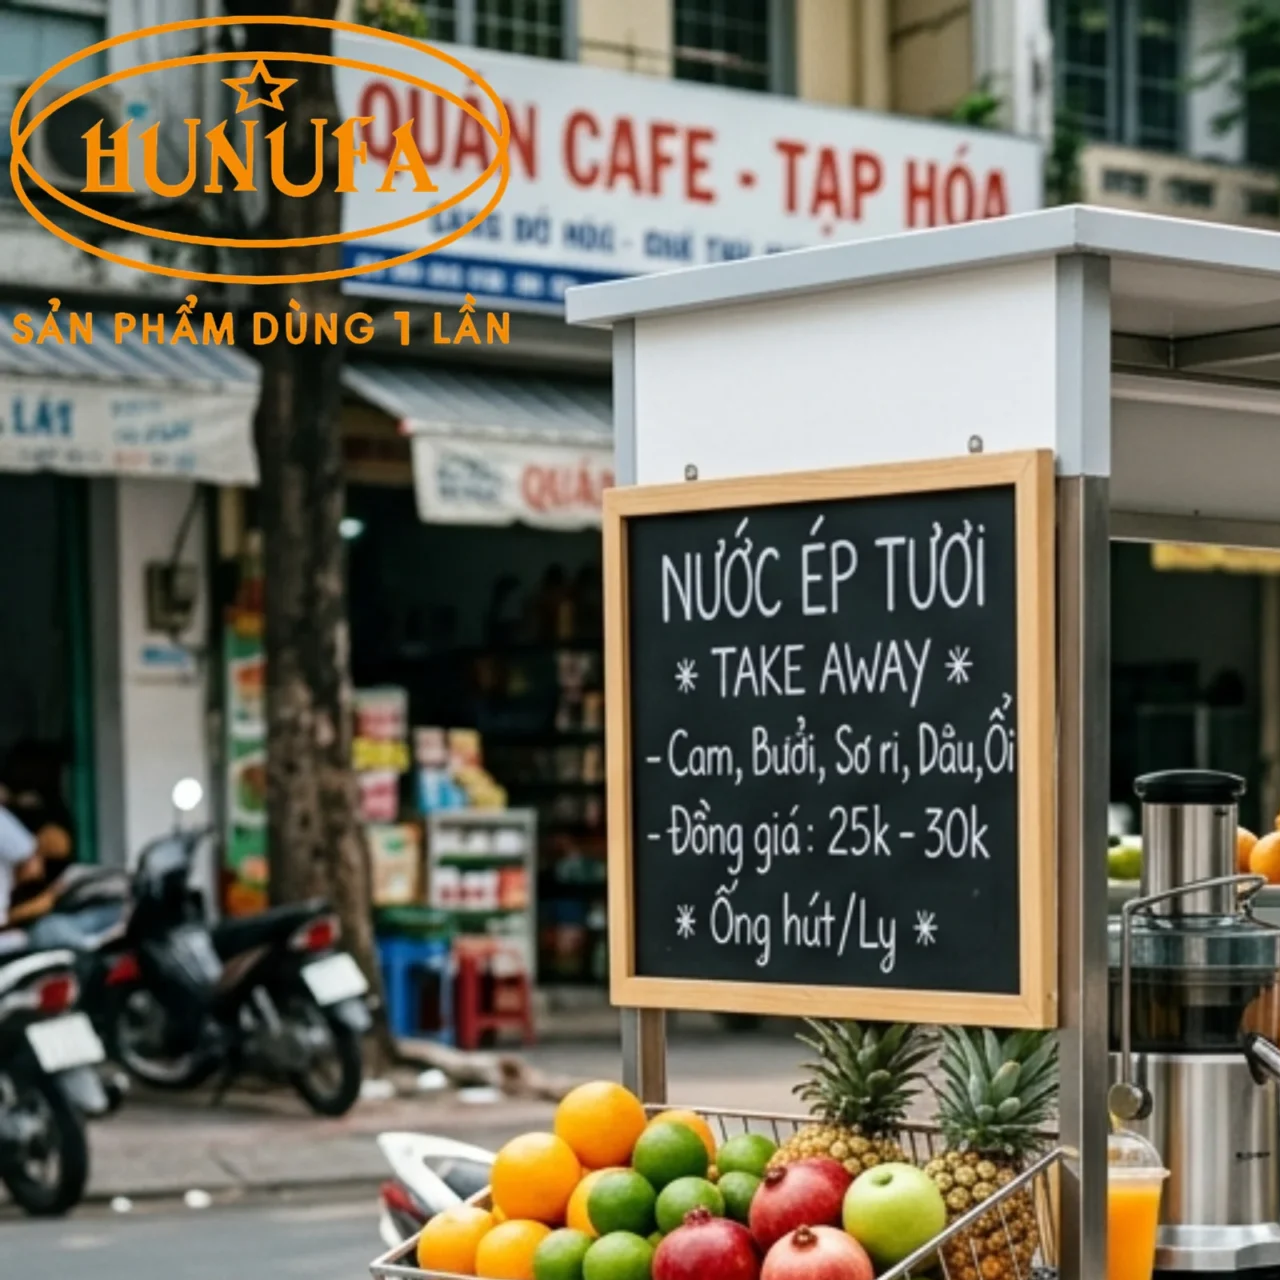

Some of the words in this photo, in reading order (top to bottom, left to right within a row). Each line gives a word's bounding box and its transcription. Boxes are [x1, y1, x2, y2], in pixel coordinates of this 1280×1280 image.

[561, 108, 717, 204] CAFE
[774, 139, 885, 236] TẠP
[904, 142, 1010, 228] HÓA
[661, 517, 782, 623] NƯỚC
[802, 515, 857, 615] ÉP
[875, 520, 984, 611] TƯƠI
[711, 645, 805, 697] TAKE
[820, 639, 931, 707] AWAY
[829, 805, 890, 855] 25k
[925, 805, 989, 858] 30k
